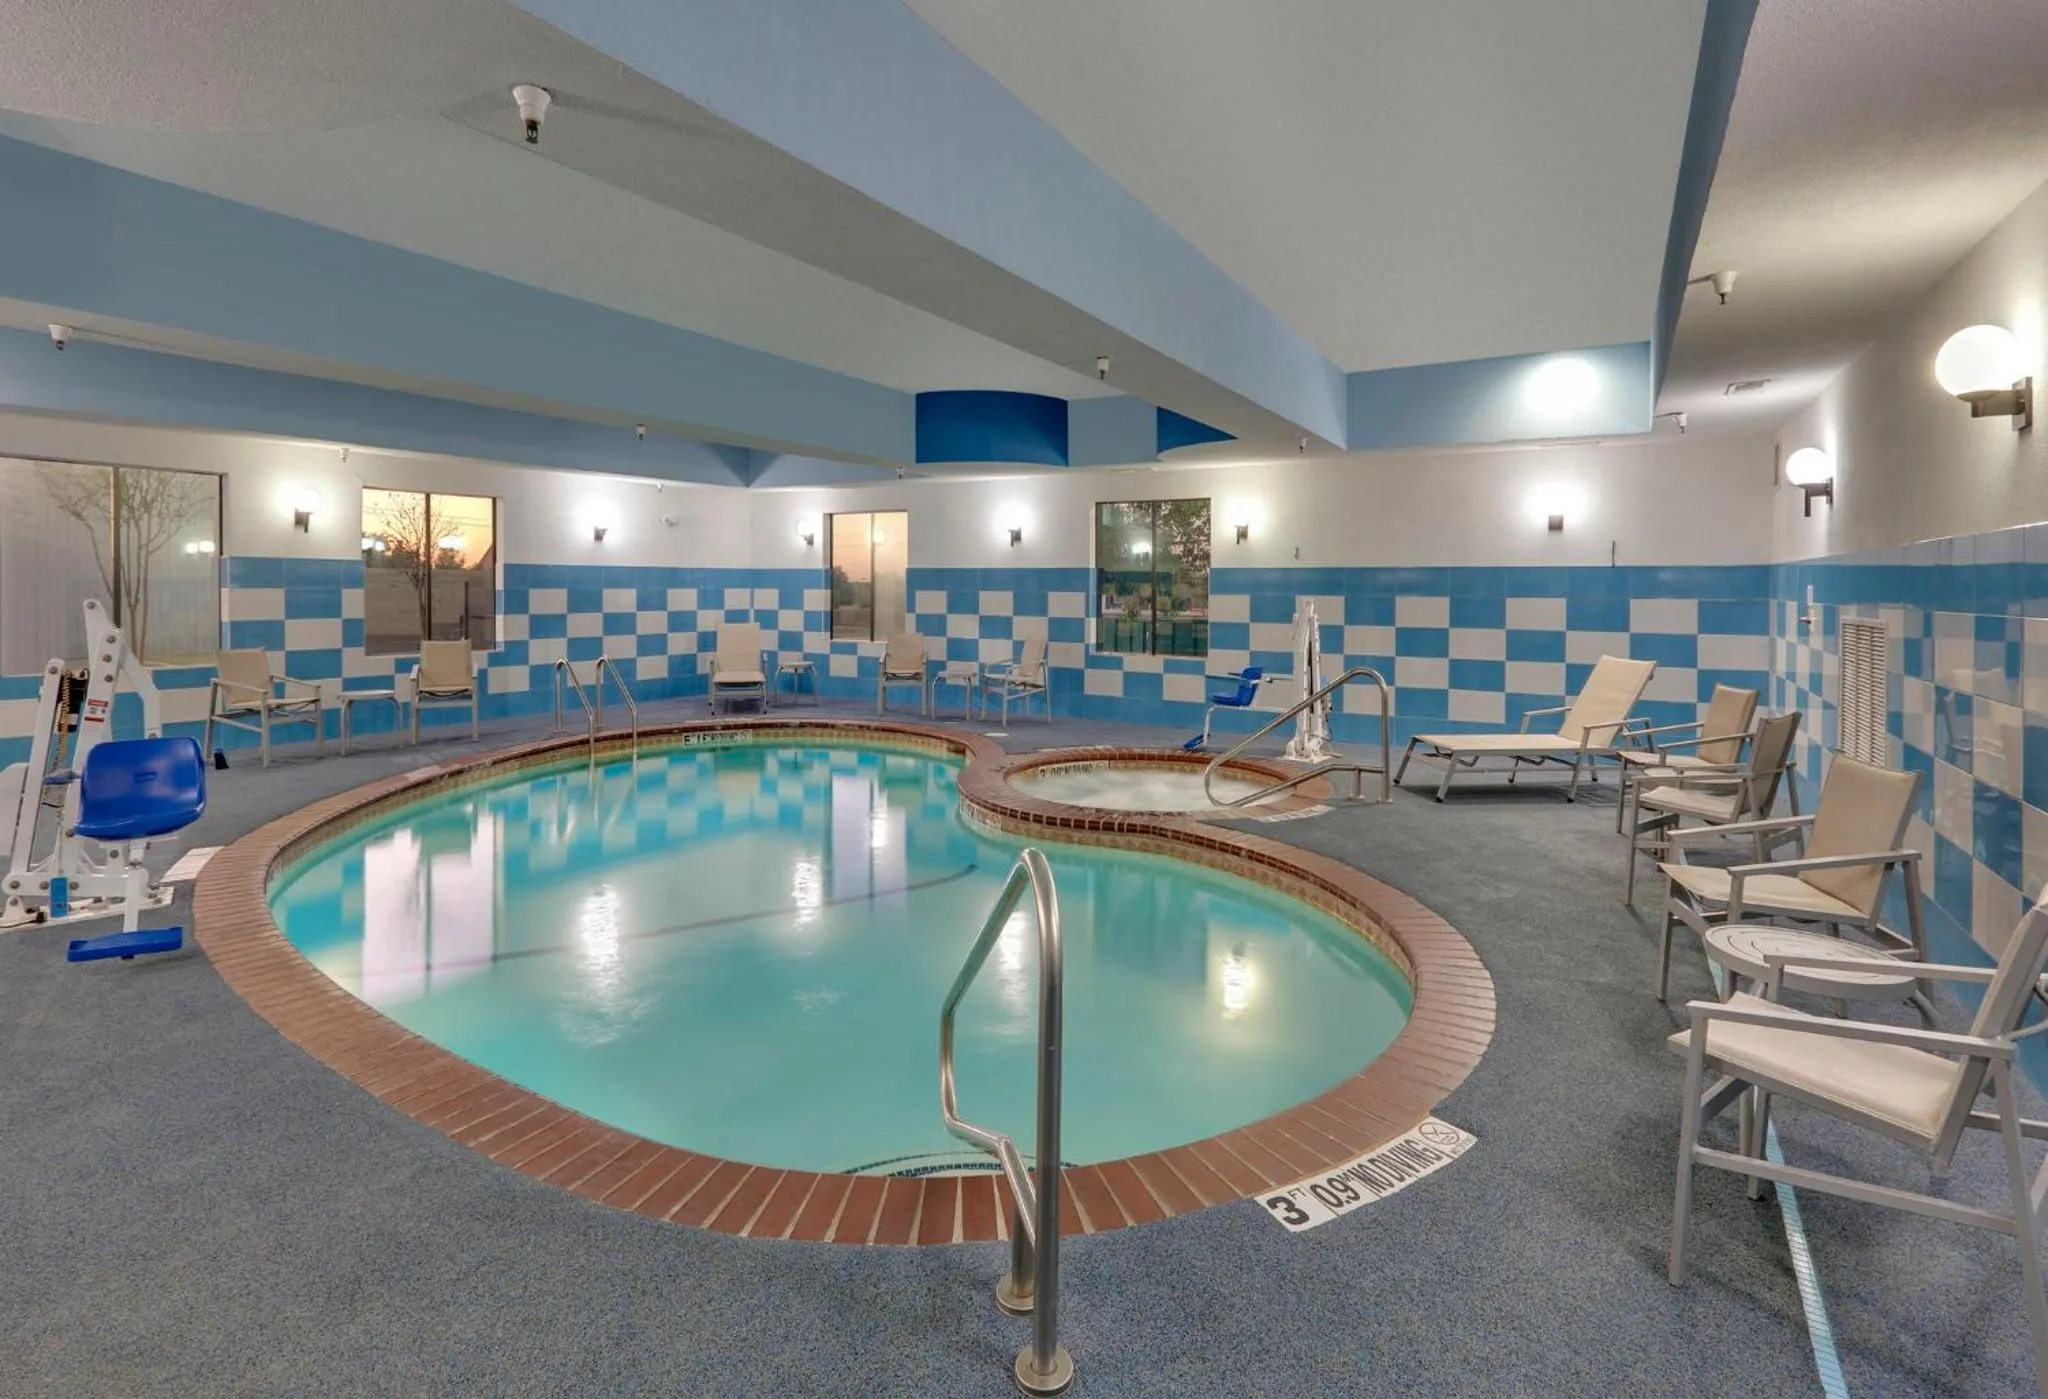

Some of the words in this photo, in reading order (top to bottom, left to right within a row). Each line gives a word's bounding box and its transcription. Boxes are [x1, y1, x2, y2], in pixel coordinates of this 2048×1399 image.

[1367, 1138, 1445, 1183] DIVING
[1287, 1187, 1306, 1201] FT
[1266, 1196, 1310, 1226] 3
